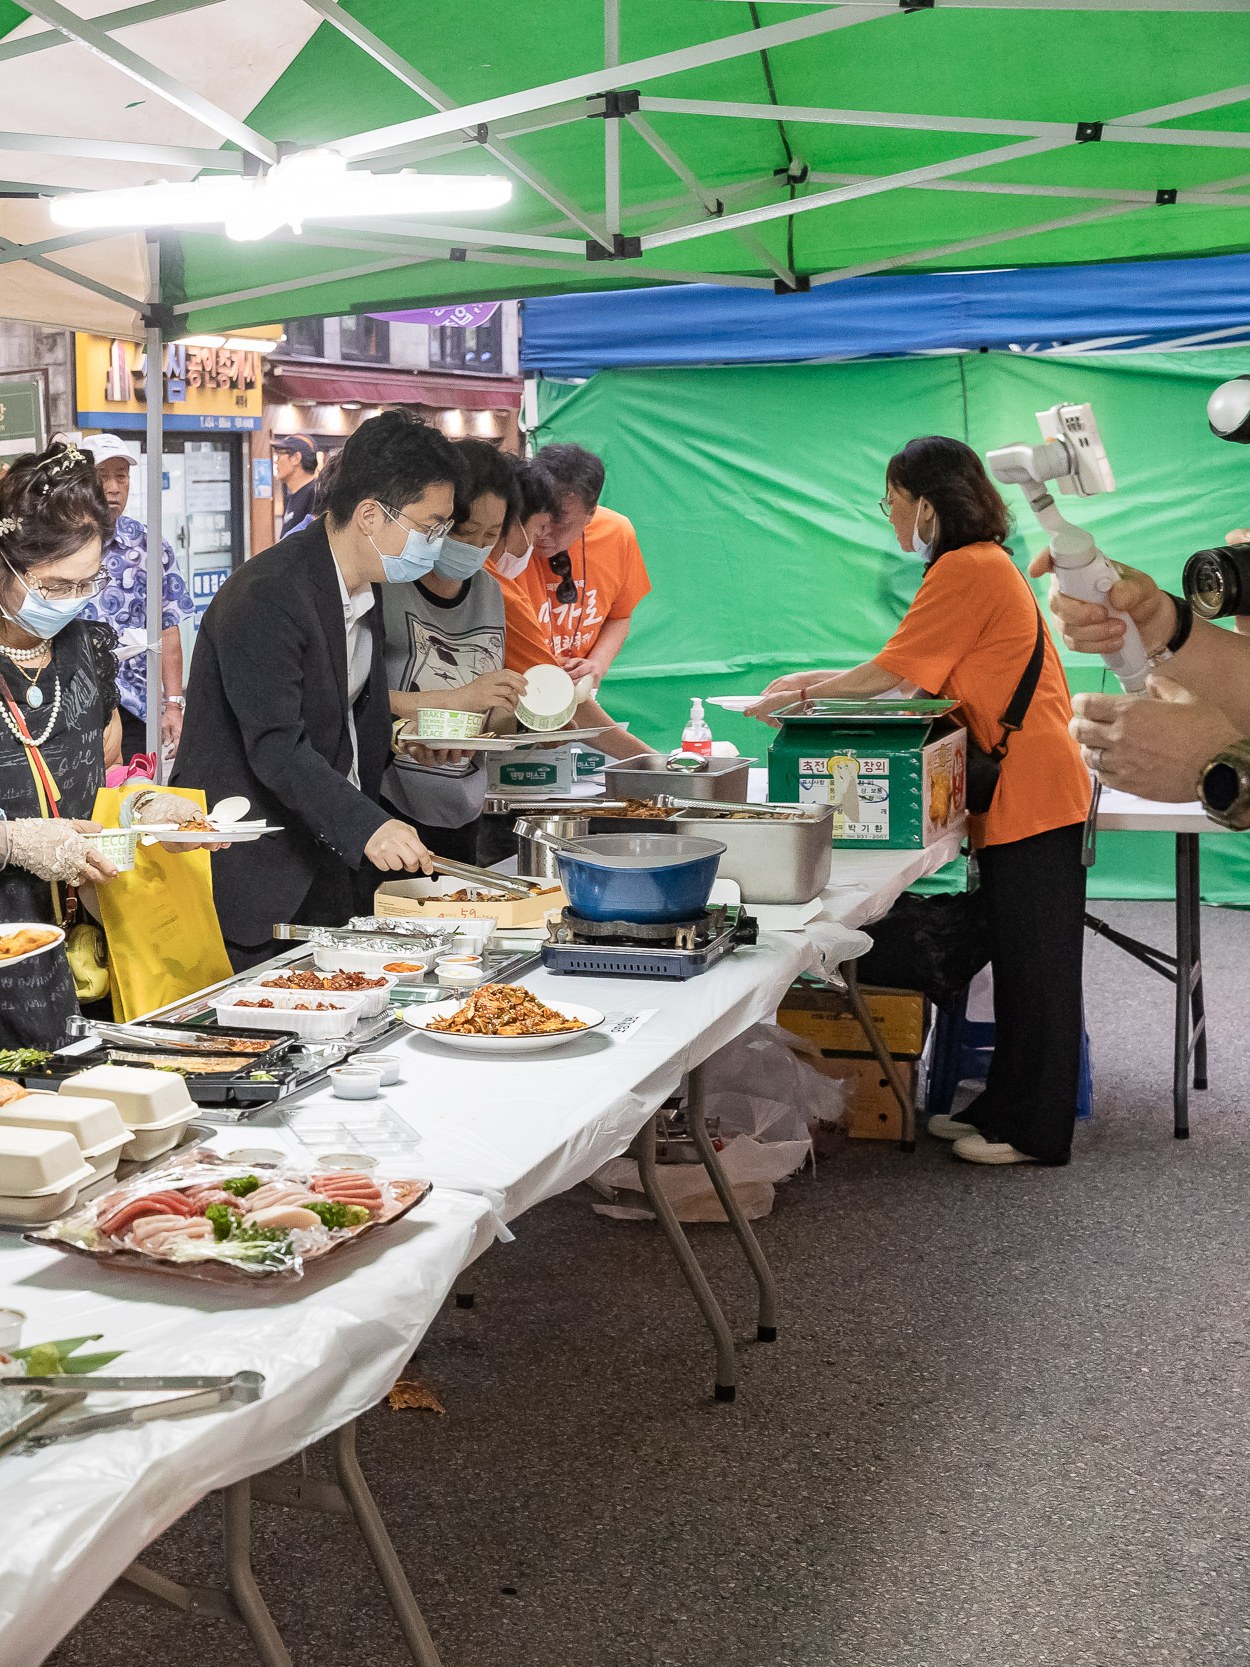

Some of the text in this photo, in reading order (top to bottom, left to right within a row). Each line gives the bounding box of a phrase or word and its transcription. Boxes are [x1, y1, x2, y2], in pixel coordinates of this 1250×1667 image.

[863, 761, 886, 772] 참외
[526, 771, 547, 780] 마스크
[102, 833, 127, 847] ECO
[102, 847, 127, 856] PAPER
[110, 856, 127, 865] OWL
